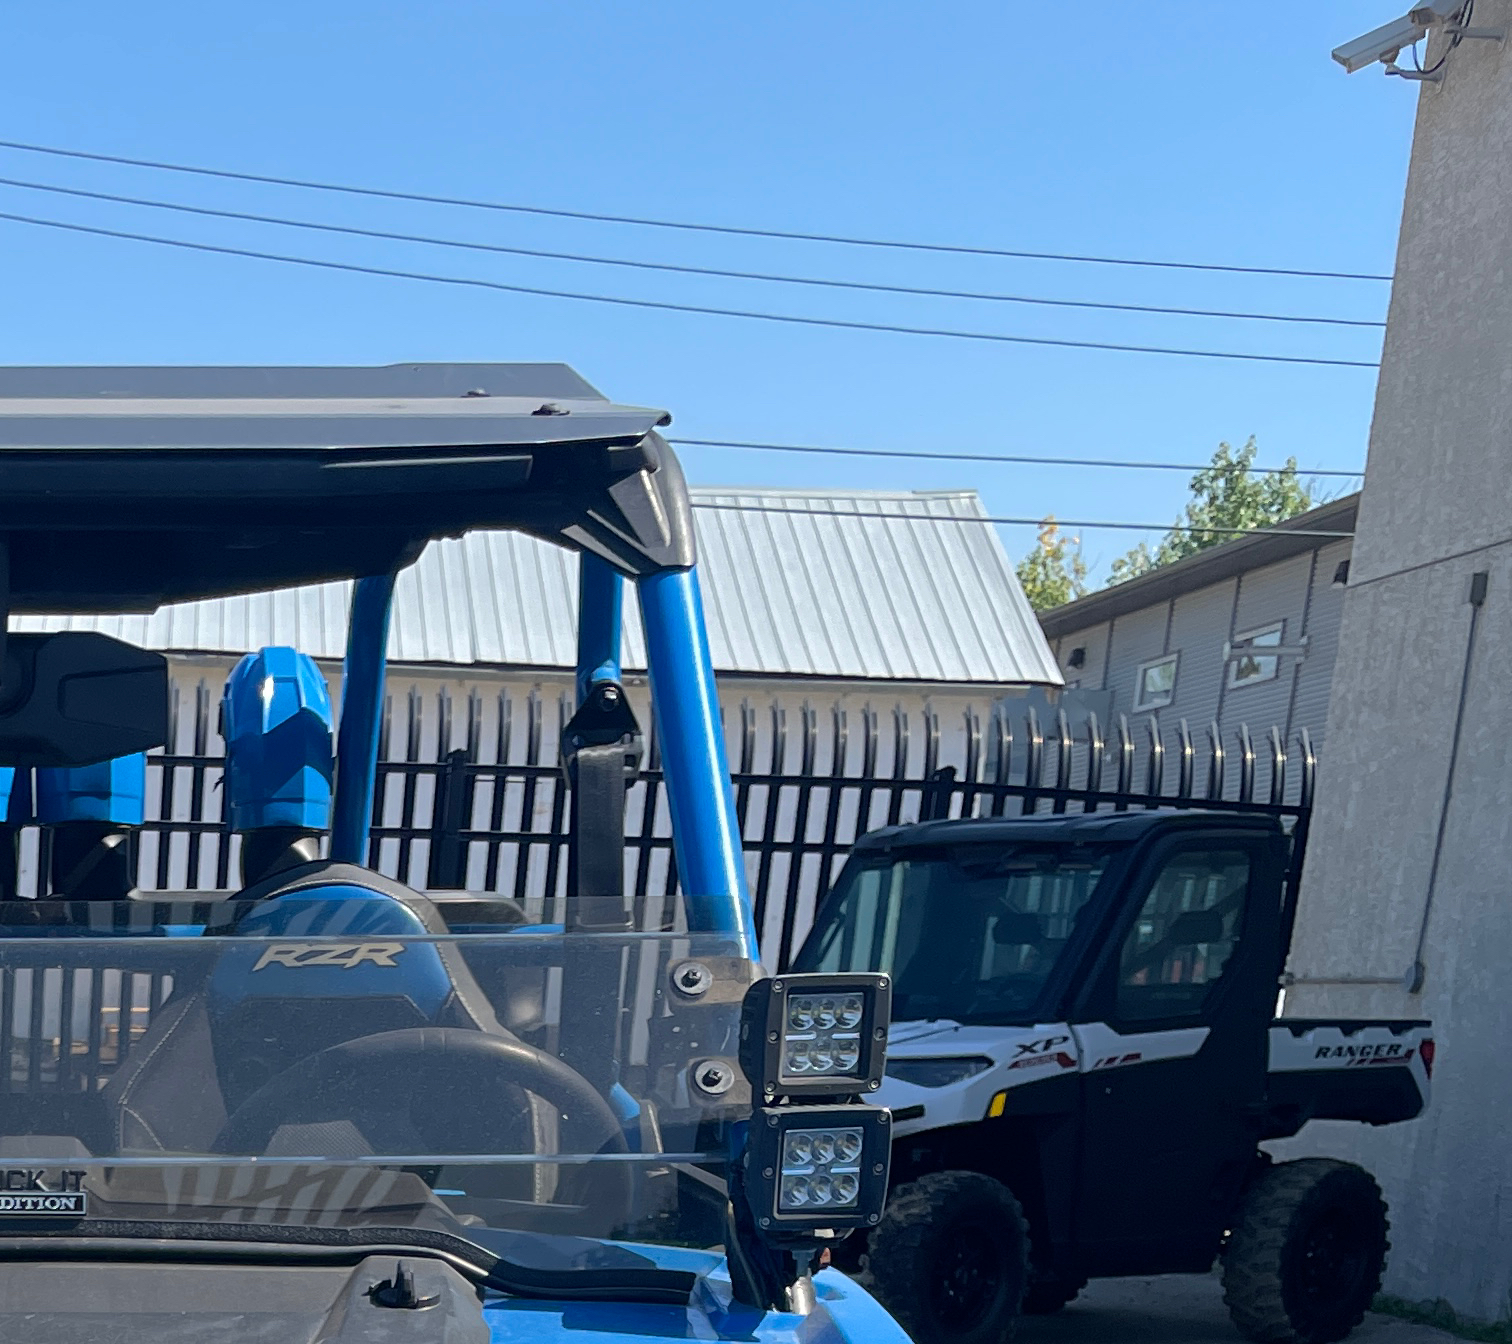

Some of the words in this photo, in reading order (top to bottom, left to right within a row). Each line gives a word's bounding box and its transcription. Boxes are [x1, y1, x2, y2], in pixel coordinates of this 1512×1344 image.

[252, 942, 405, 971] RZR
[1011, 1036, 1070, 1058] XP
[1314, 1043, 1403, 1059] RANGER
[61, 1169, 87, 1192] IT
